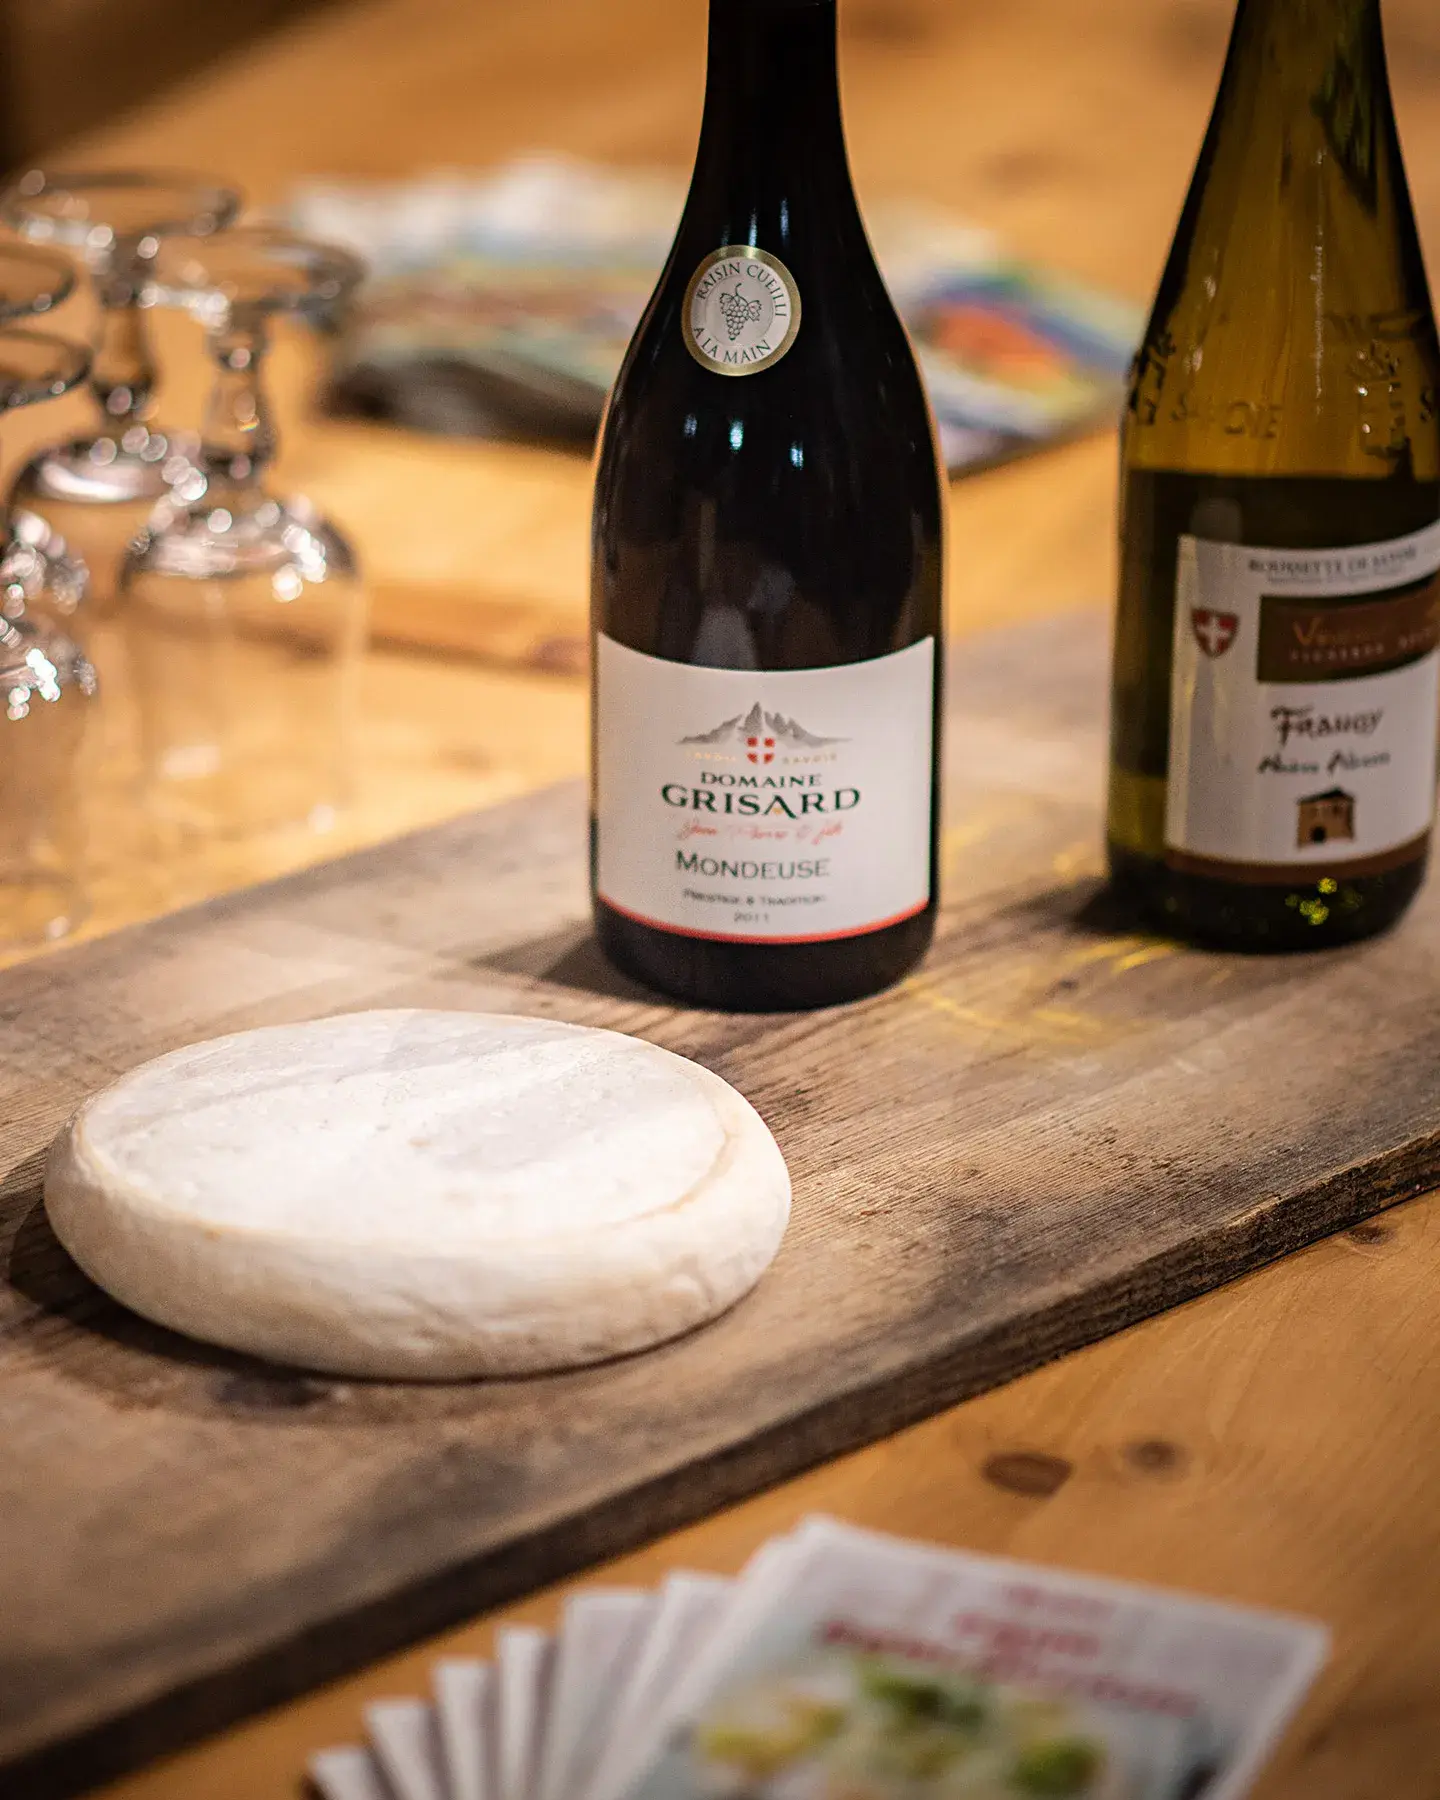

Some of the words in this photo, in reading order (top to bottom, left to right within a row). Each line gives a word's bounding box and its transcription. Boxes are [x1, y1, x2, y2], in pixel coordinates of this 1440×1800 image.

[697, 261, 741, 300] RAISIN
[746, 264, 788, 317] CUEILLI
[701, 337, 719, 358] LA
[723, 339, 772, 364] MAIN
[700, 771, 823, 788] DOMAINE
[661, 782, 861, 819] GRISARD
[674, 848, 831, 880] MONDEUSE
